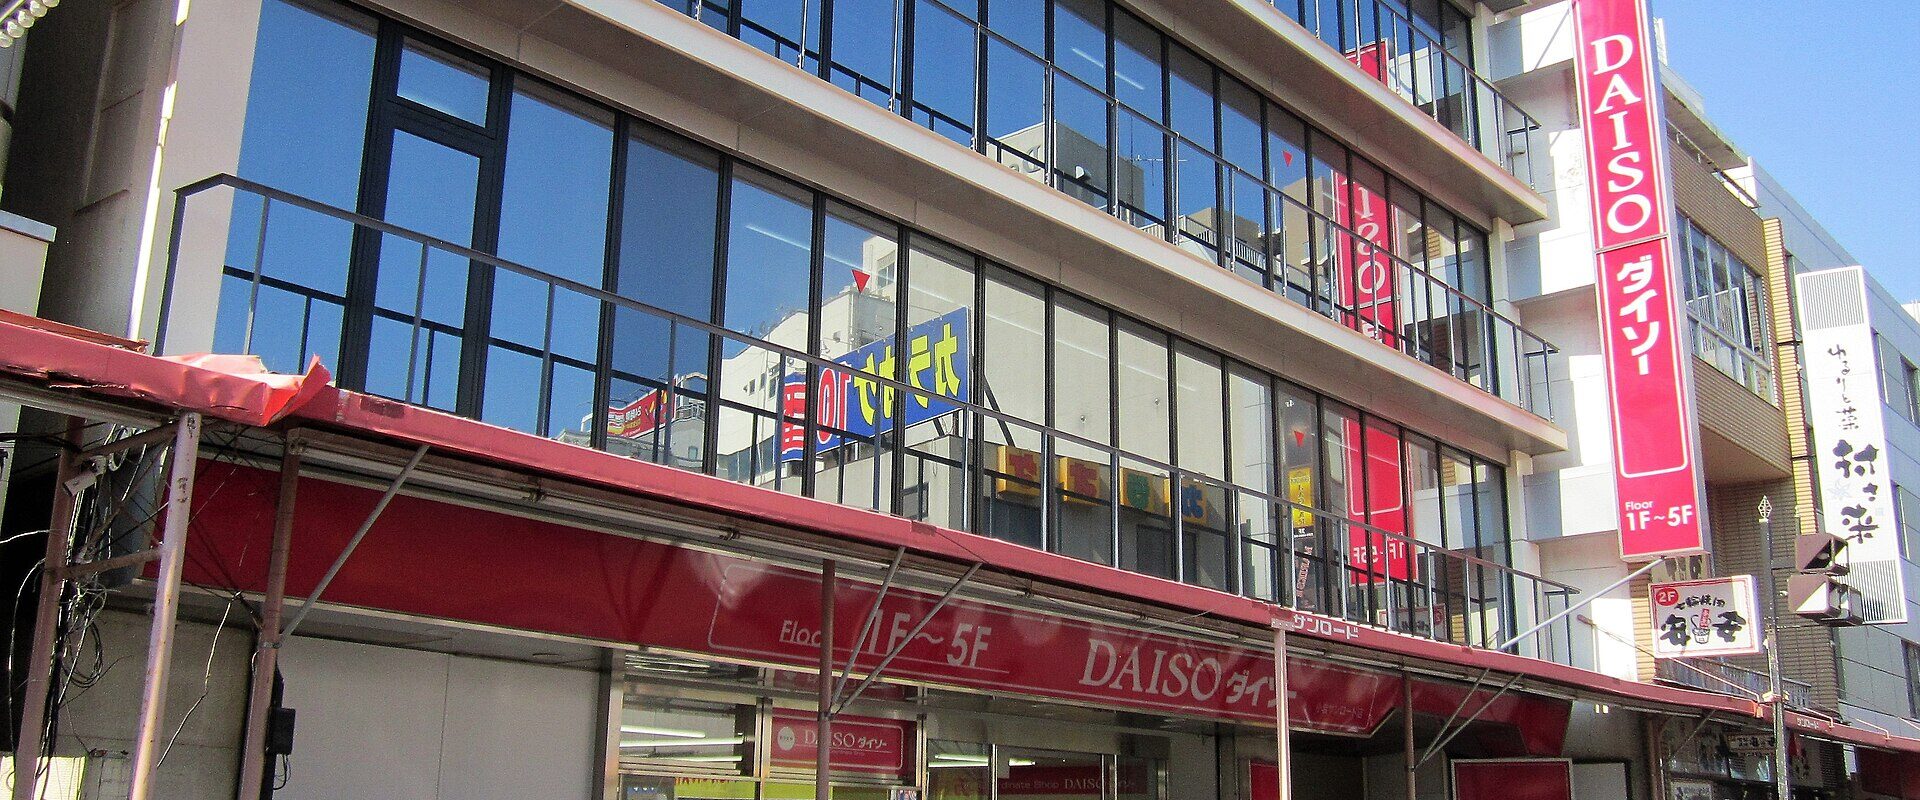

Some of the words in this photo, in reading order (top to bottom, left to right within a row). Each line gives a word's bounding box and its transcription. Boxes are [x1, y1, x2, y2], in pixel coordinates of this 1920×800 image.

[1590, 34, 1651, 234] DAISO
[1616, 254, 1660, 376] ダイソー
[1625, 500, 1653, 511] Floor
[1658, 592, 1676, 603] 2F
[778, 619, 823, 647] Floo
[1293, 614, 1359, 640] サンロード
[1078, 638, 1222, 701] DAISO
[803, 728, 855, 748] DSO
